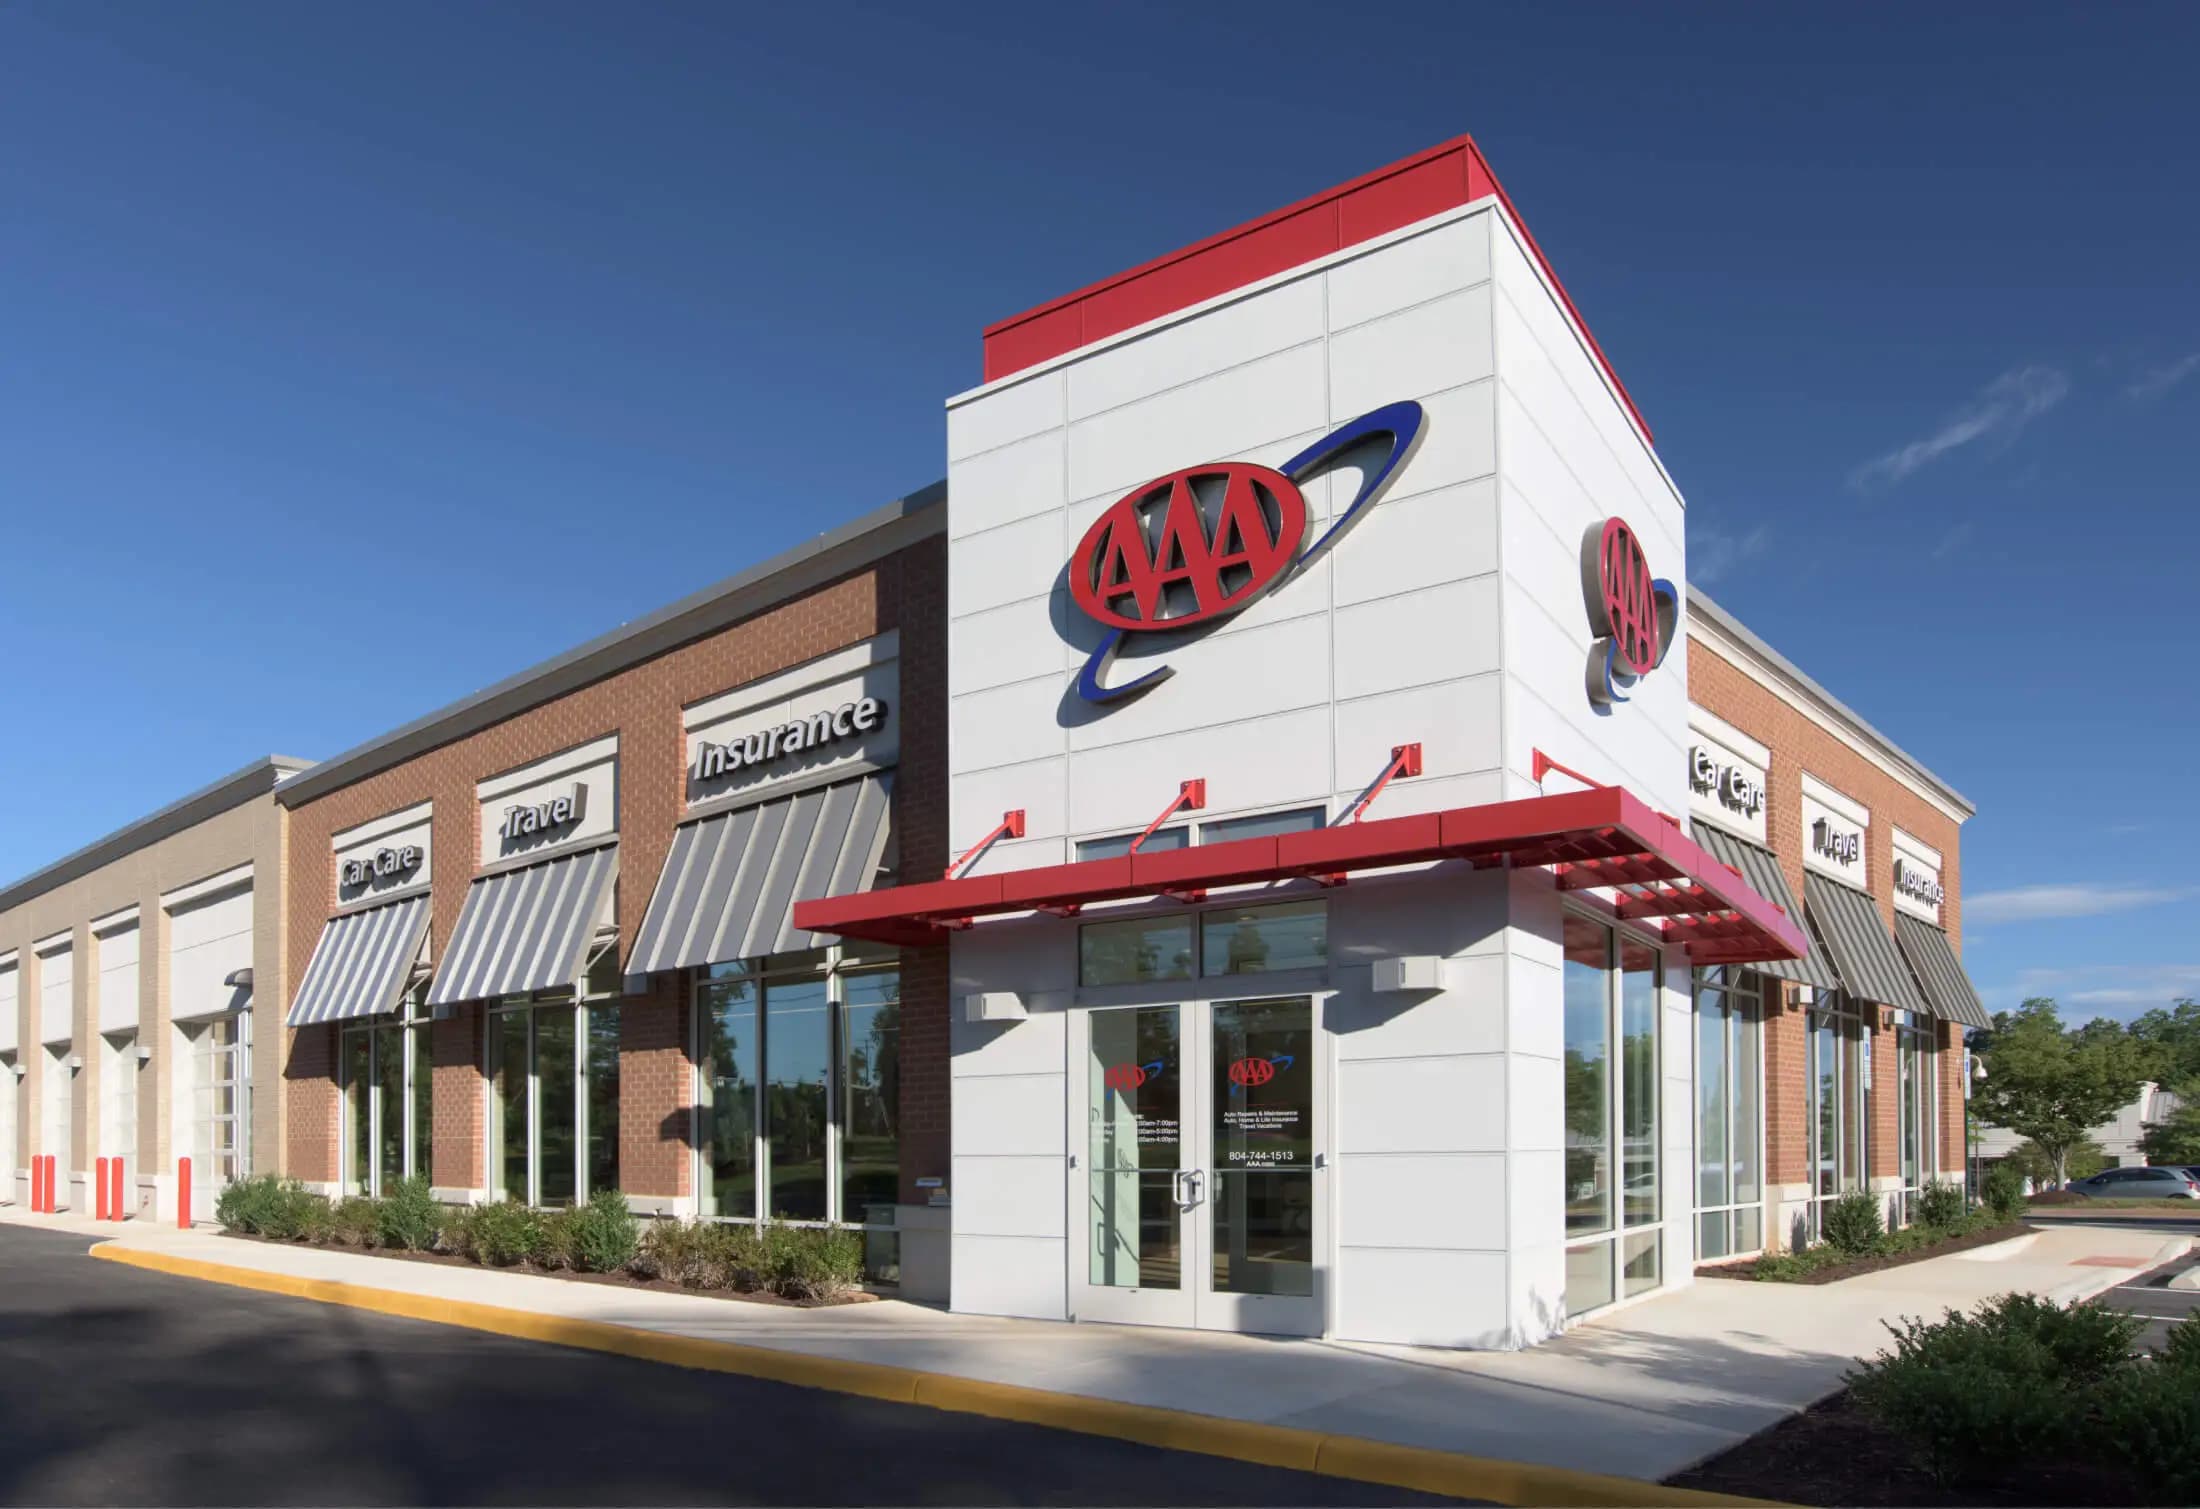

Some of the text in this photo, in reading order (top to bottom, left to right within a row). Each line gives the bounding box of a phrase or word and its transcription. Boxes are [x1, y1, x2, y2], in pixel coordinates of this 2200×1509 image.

[1080, 464, 1296, 628] AAA
[1601, 518, 1658, 673] AAA
[694, 697, 880, 781] Insurance
[1692, 745, 1765, 811] Car Care
[503, 782, 579, 840] Travel
[340, 845, 417, 887] Car Care
[1898, 859, 1944, 905] Insurance
[1230, 1058, 1275, 1087] AAA
[1229, 1151, 1294, 1161] 804-744-1513
